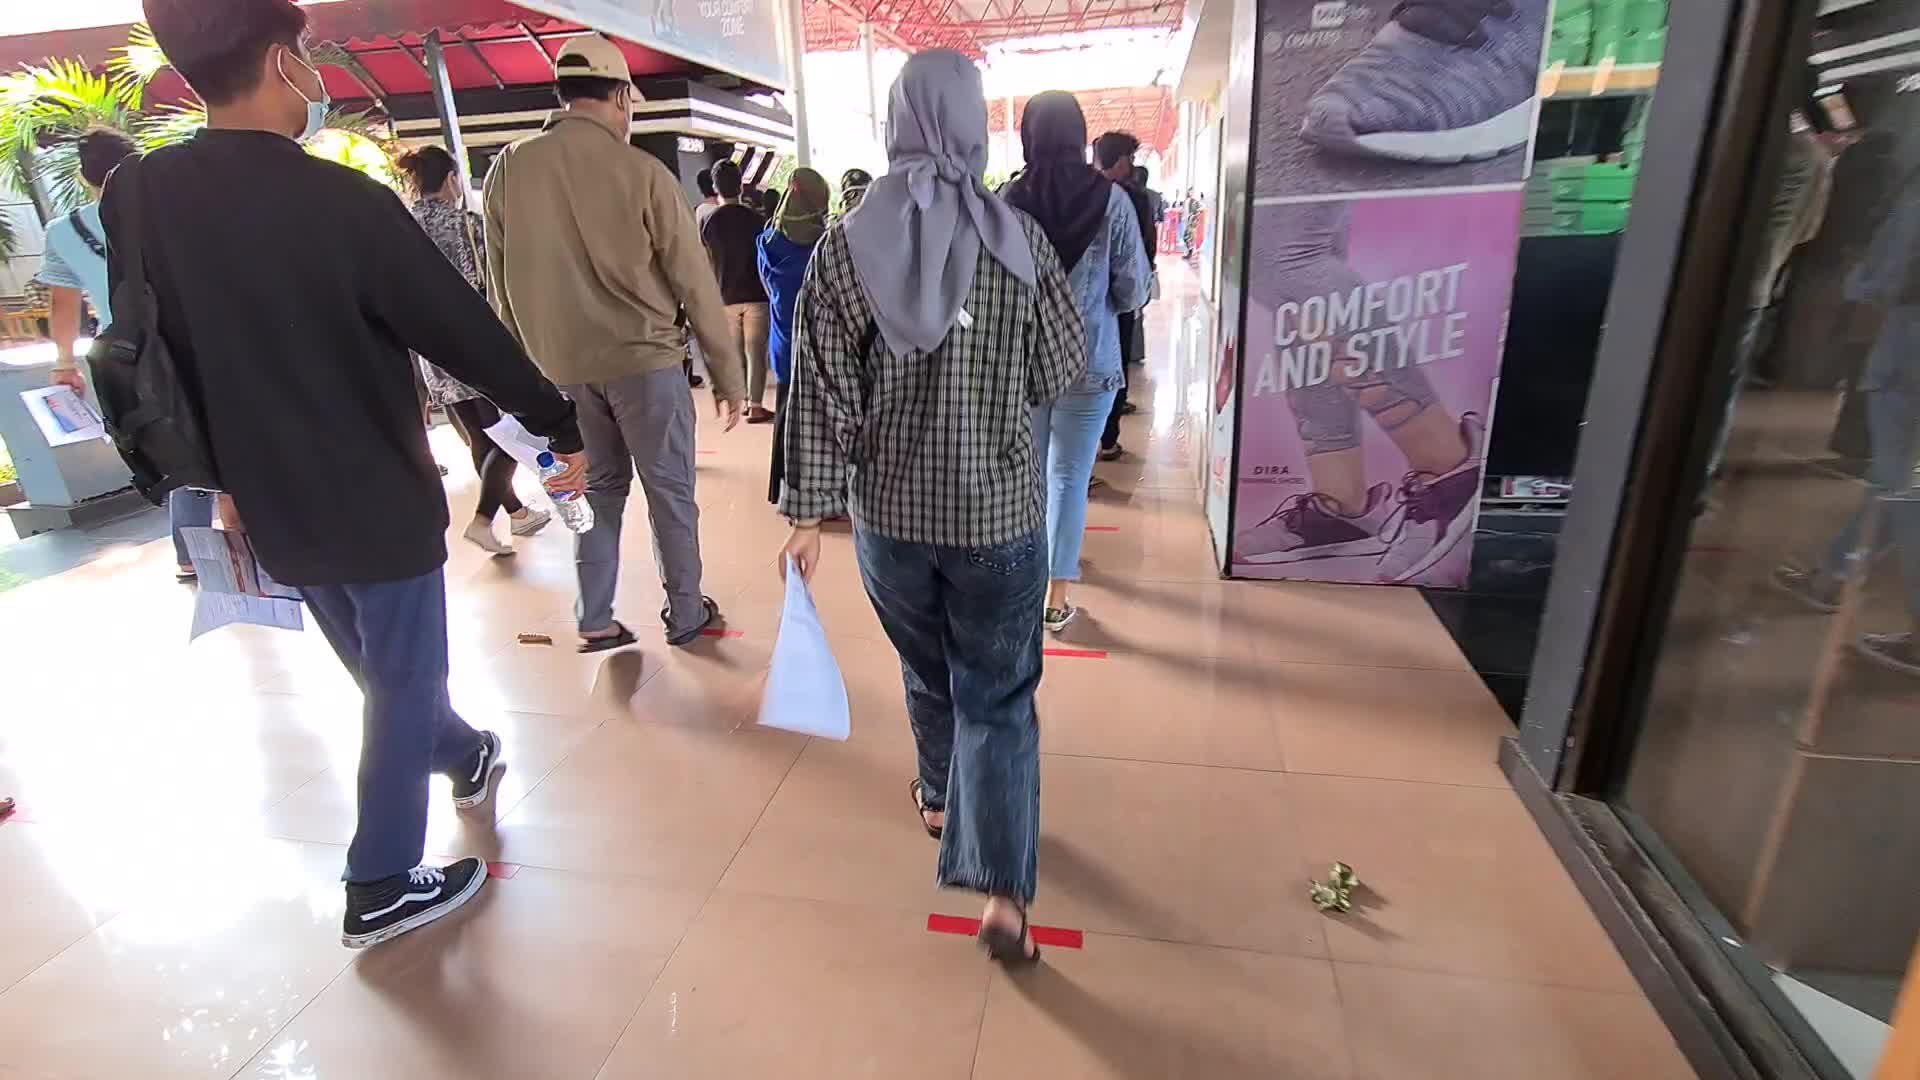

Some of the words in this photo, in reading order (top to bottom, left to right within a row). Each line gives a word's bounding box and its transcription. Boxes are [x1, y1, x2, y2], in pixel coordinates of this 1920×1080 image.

[720, 15, 744, 35] ZONE
[1275, 262, 1469, 346] COMFORT
[1253, 341, 1332, 397] AND
[1345, 312, 1468, 378] STYLE
[1253, 465, 1289, 475] DIRA
